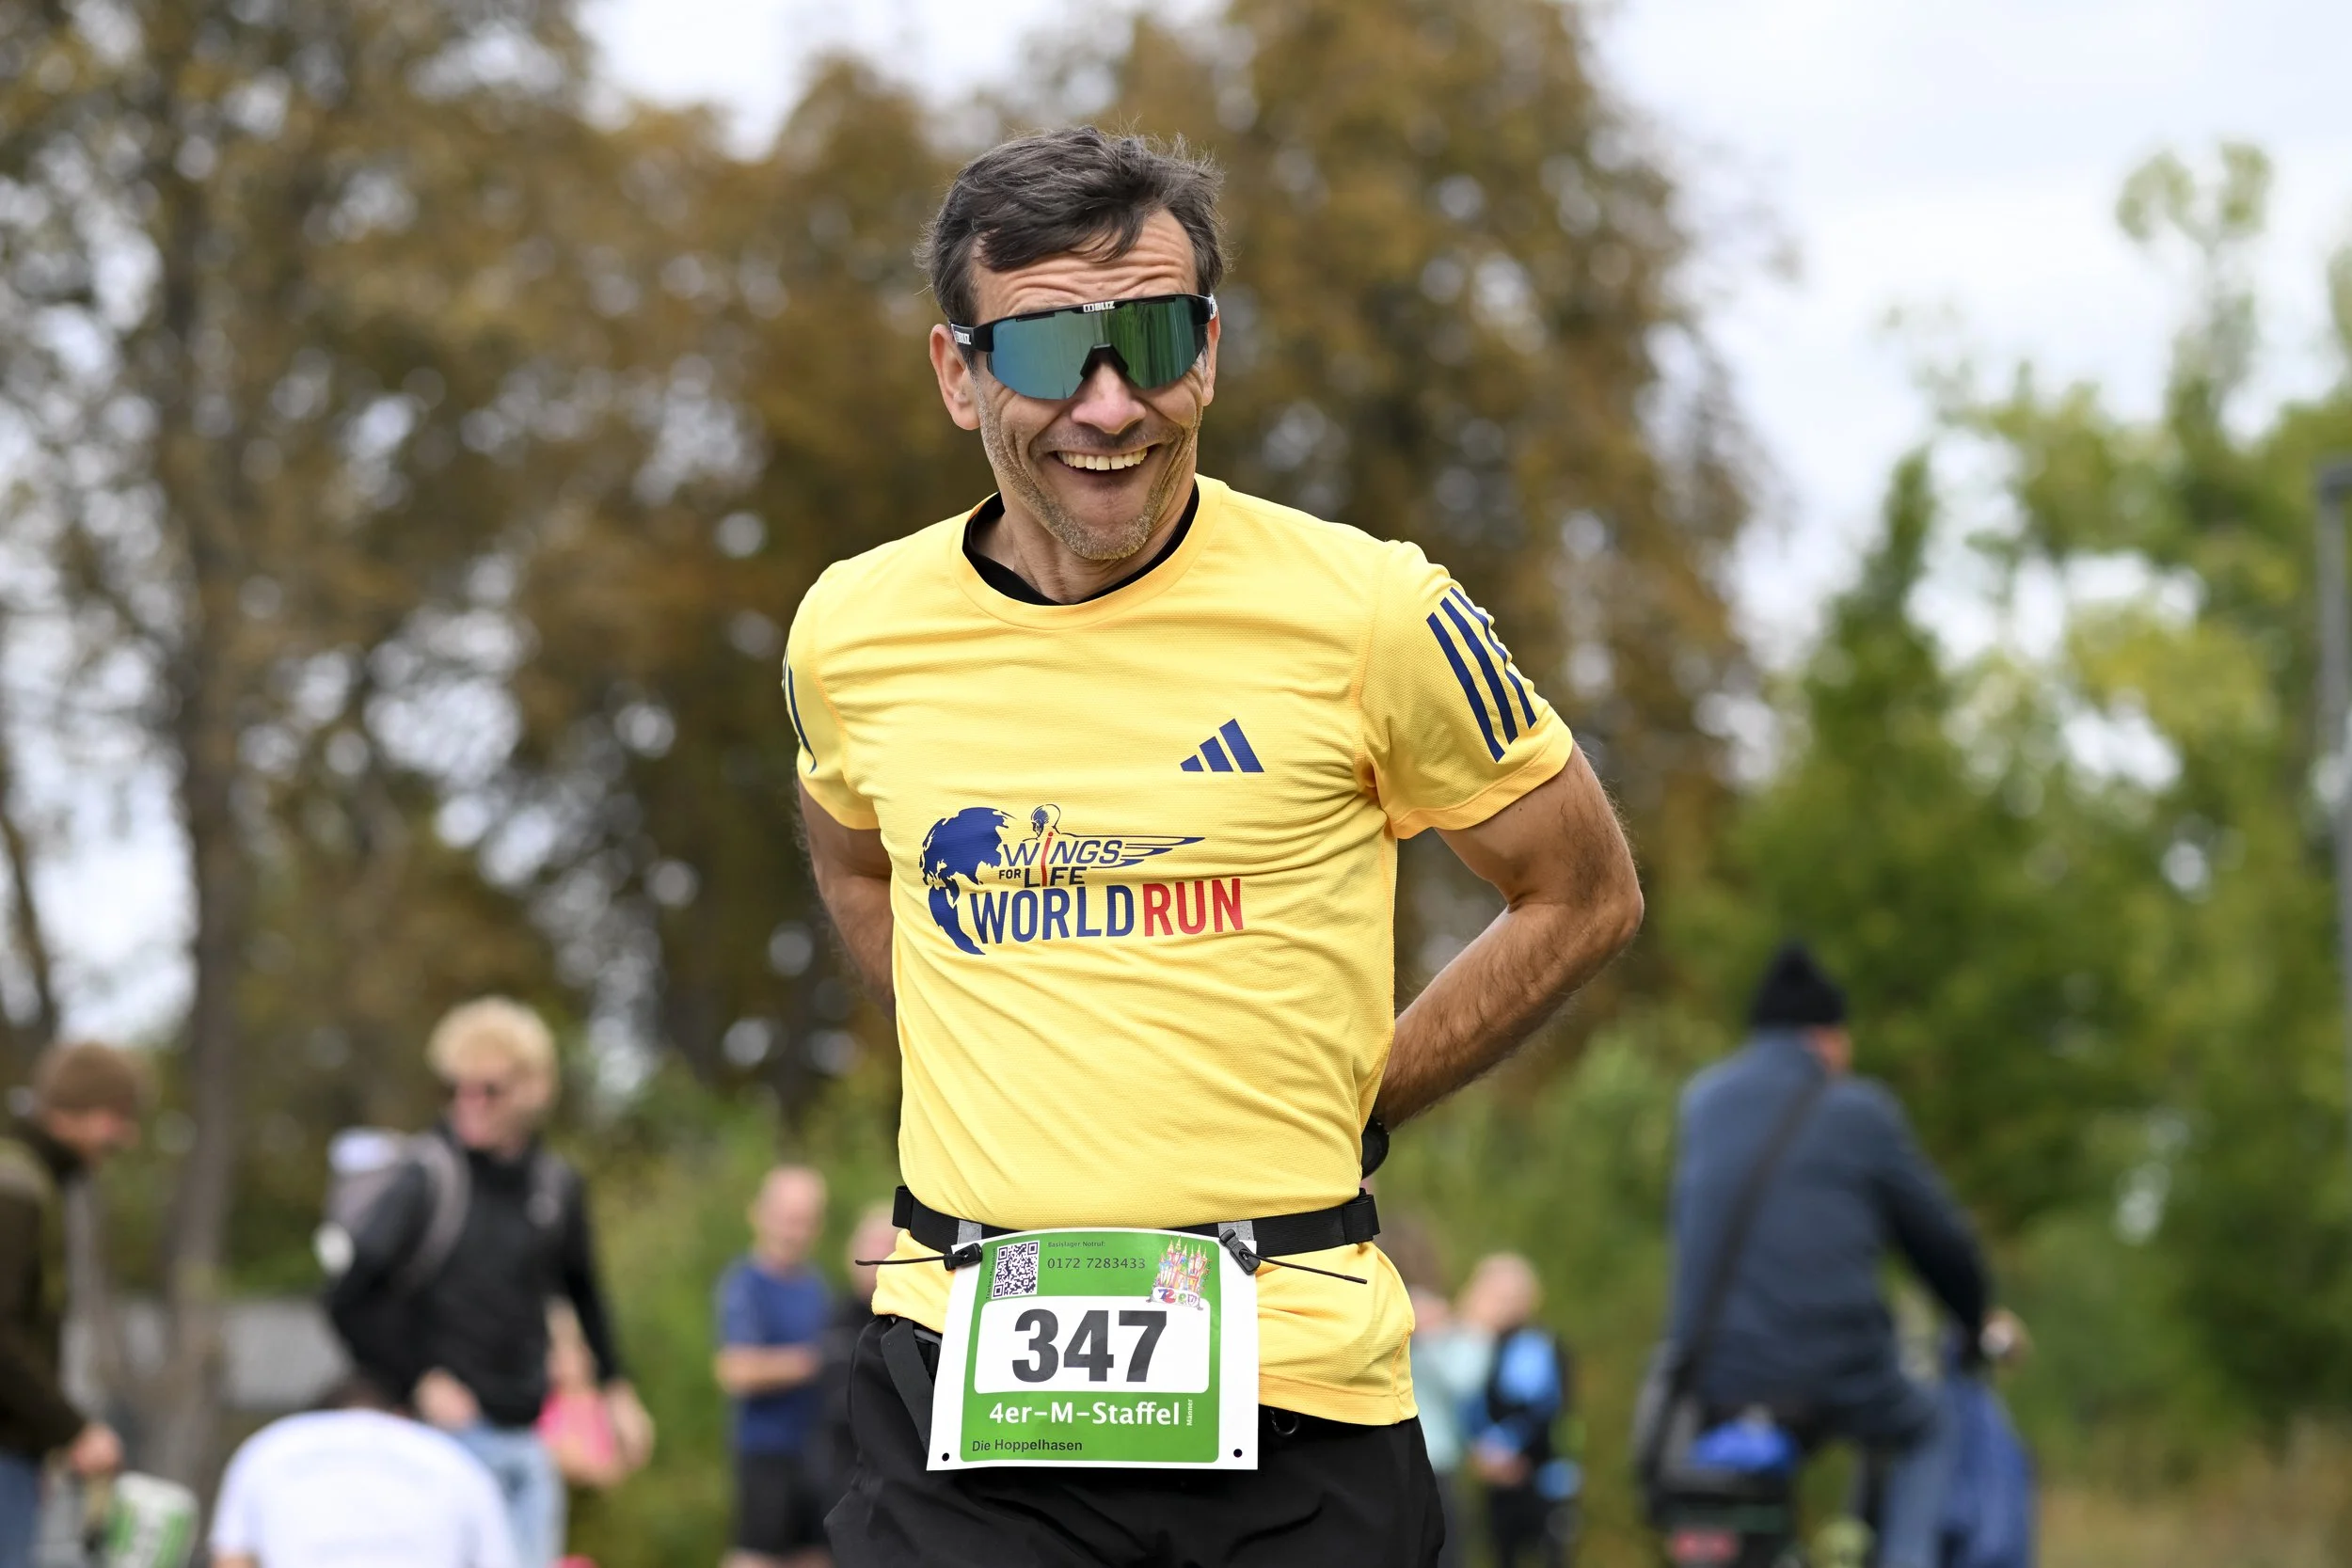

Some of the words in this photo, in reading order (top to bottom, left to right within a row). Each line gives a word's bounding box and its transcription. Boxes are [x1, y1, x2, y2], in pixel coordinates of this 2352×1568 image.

[999, 868, 1022, 880] FOR
[1025, 866, 1088, 888] LIFE
[969, 884, 1135, 944] WORLD
[1142, 878, 1244, 937] RUN
[1047, 1258, 1081, 1269] 0172
[1086, 1258, 1146, 1269] 7283433
[1011, 1308, 1168, 1383] 347
[989, 1401, 1180, 1426] 4er-M-Staffel
[972, 1440, 991, 1451] Die
[994, 1438, 1083, 1452] Hoppelhasen
